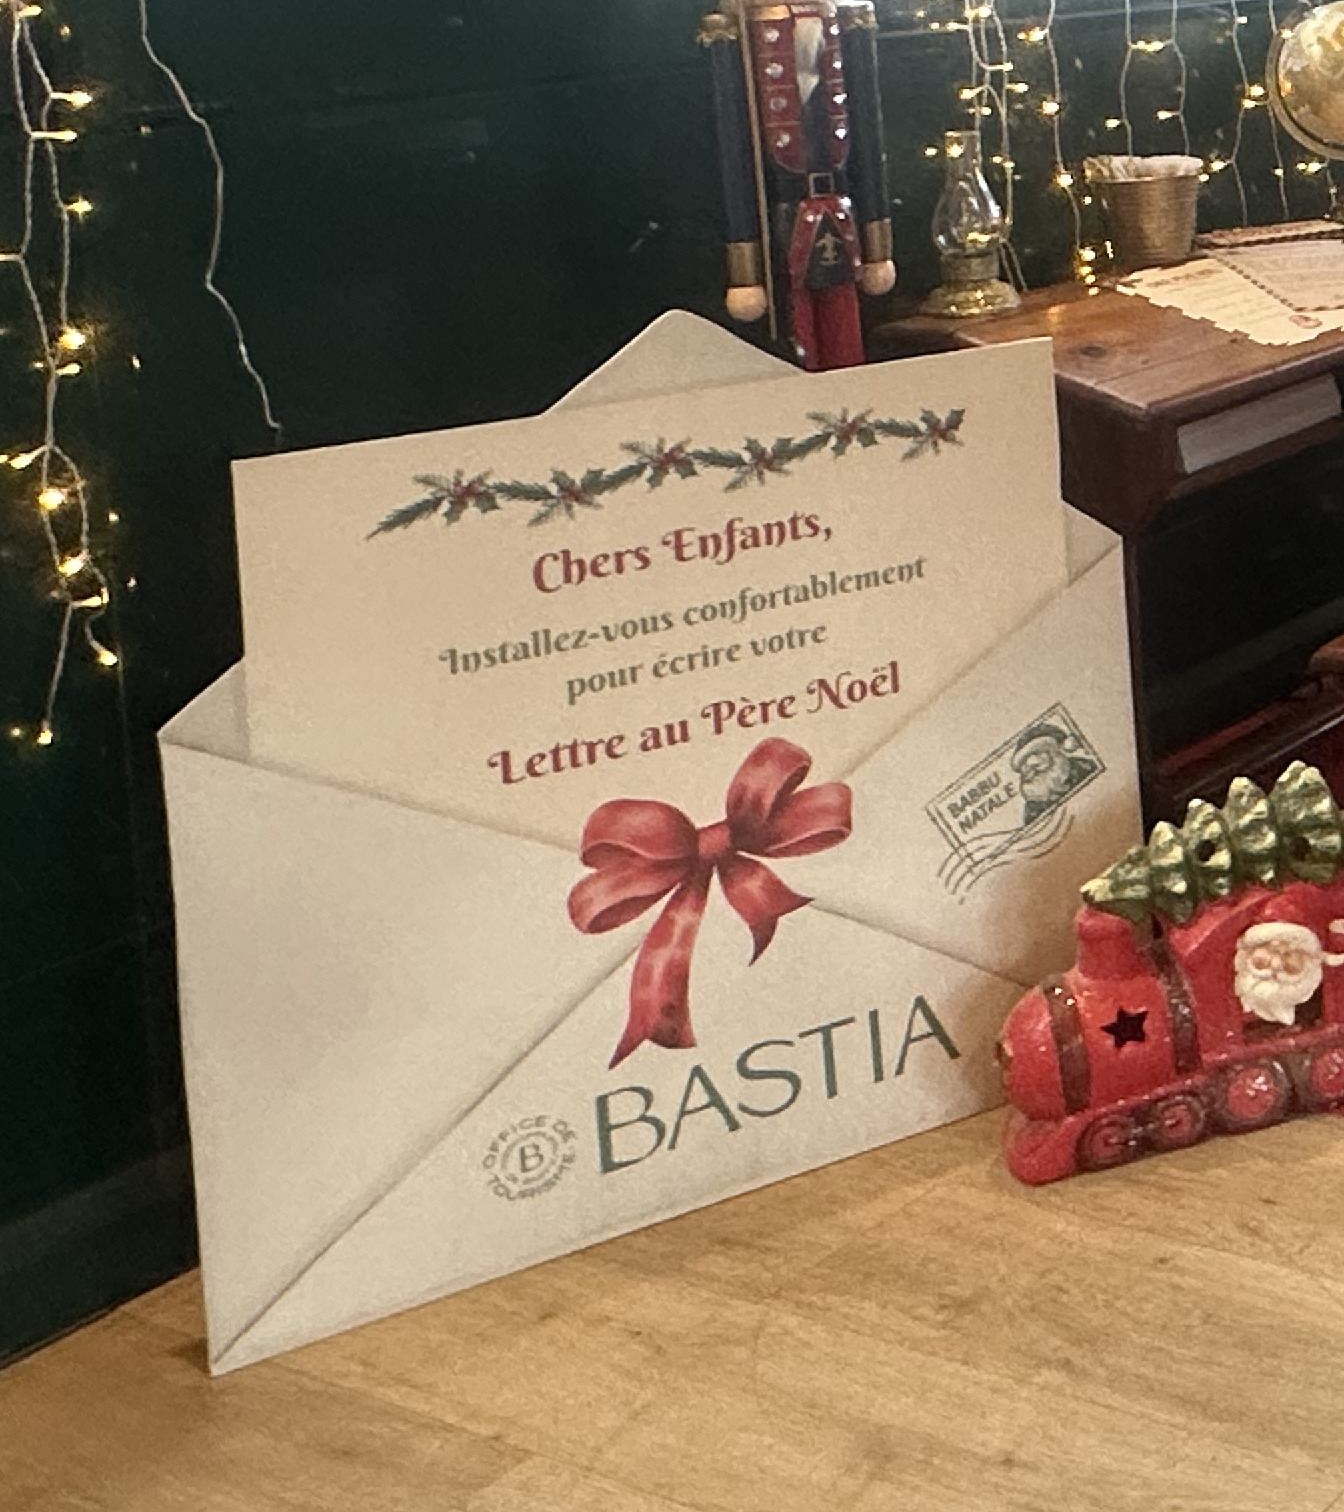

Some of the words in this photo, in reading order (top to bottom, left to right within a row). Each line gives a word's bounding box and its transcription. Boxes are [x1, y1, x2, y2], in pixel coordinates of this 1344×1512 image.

[532, 549, 651, 593] Chers
[661, 511, 832, 565] Enfants,
[438, 612, 674, 675] Installez-vous
[683, 556, 926, 627] confortablement
[565, 663, 643, 705] pour
[652, 639, 742, 679] écrire
[750, 621, 828, 658] votre
[487, 732, 627, 785] Lettre
[639, 719, 690, 753] au
[701, 692, 797, 736] Père
[805, 660, 901, 714] Noël
[958, 782, 1016, 834] NATALE
[595, 995, 961, 1174] BASTIA
[519, 1142, 544, 1173] B
